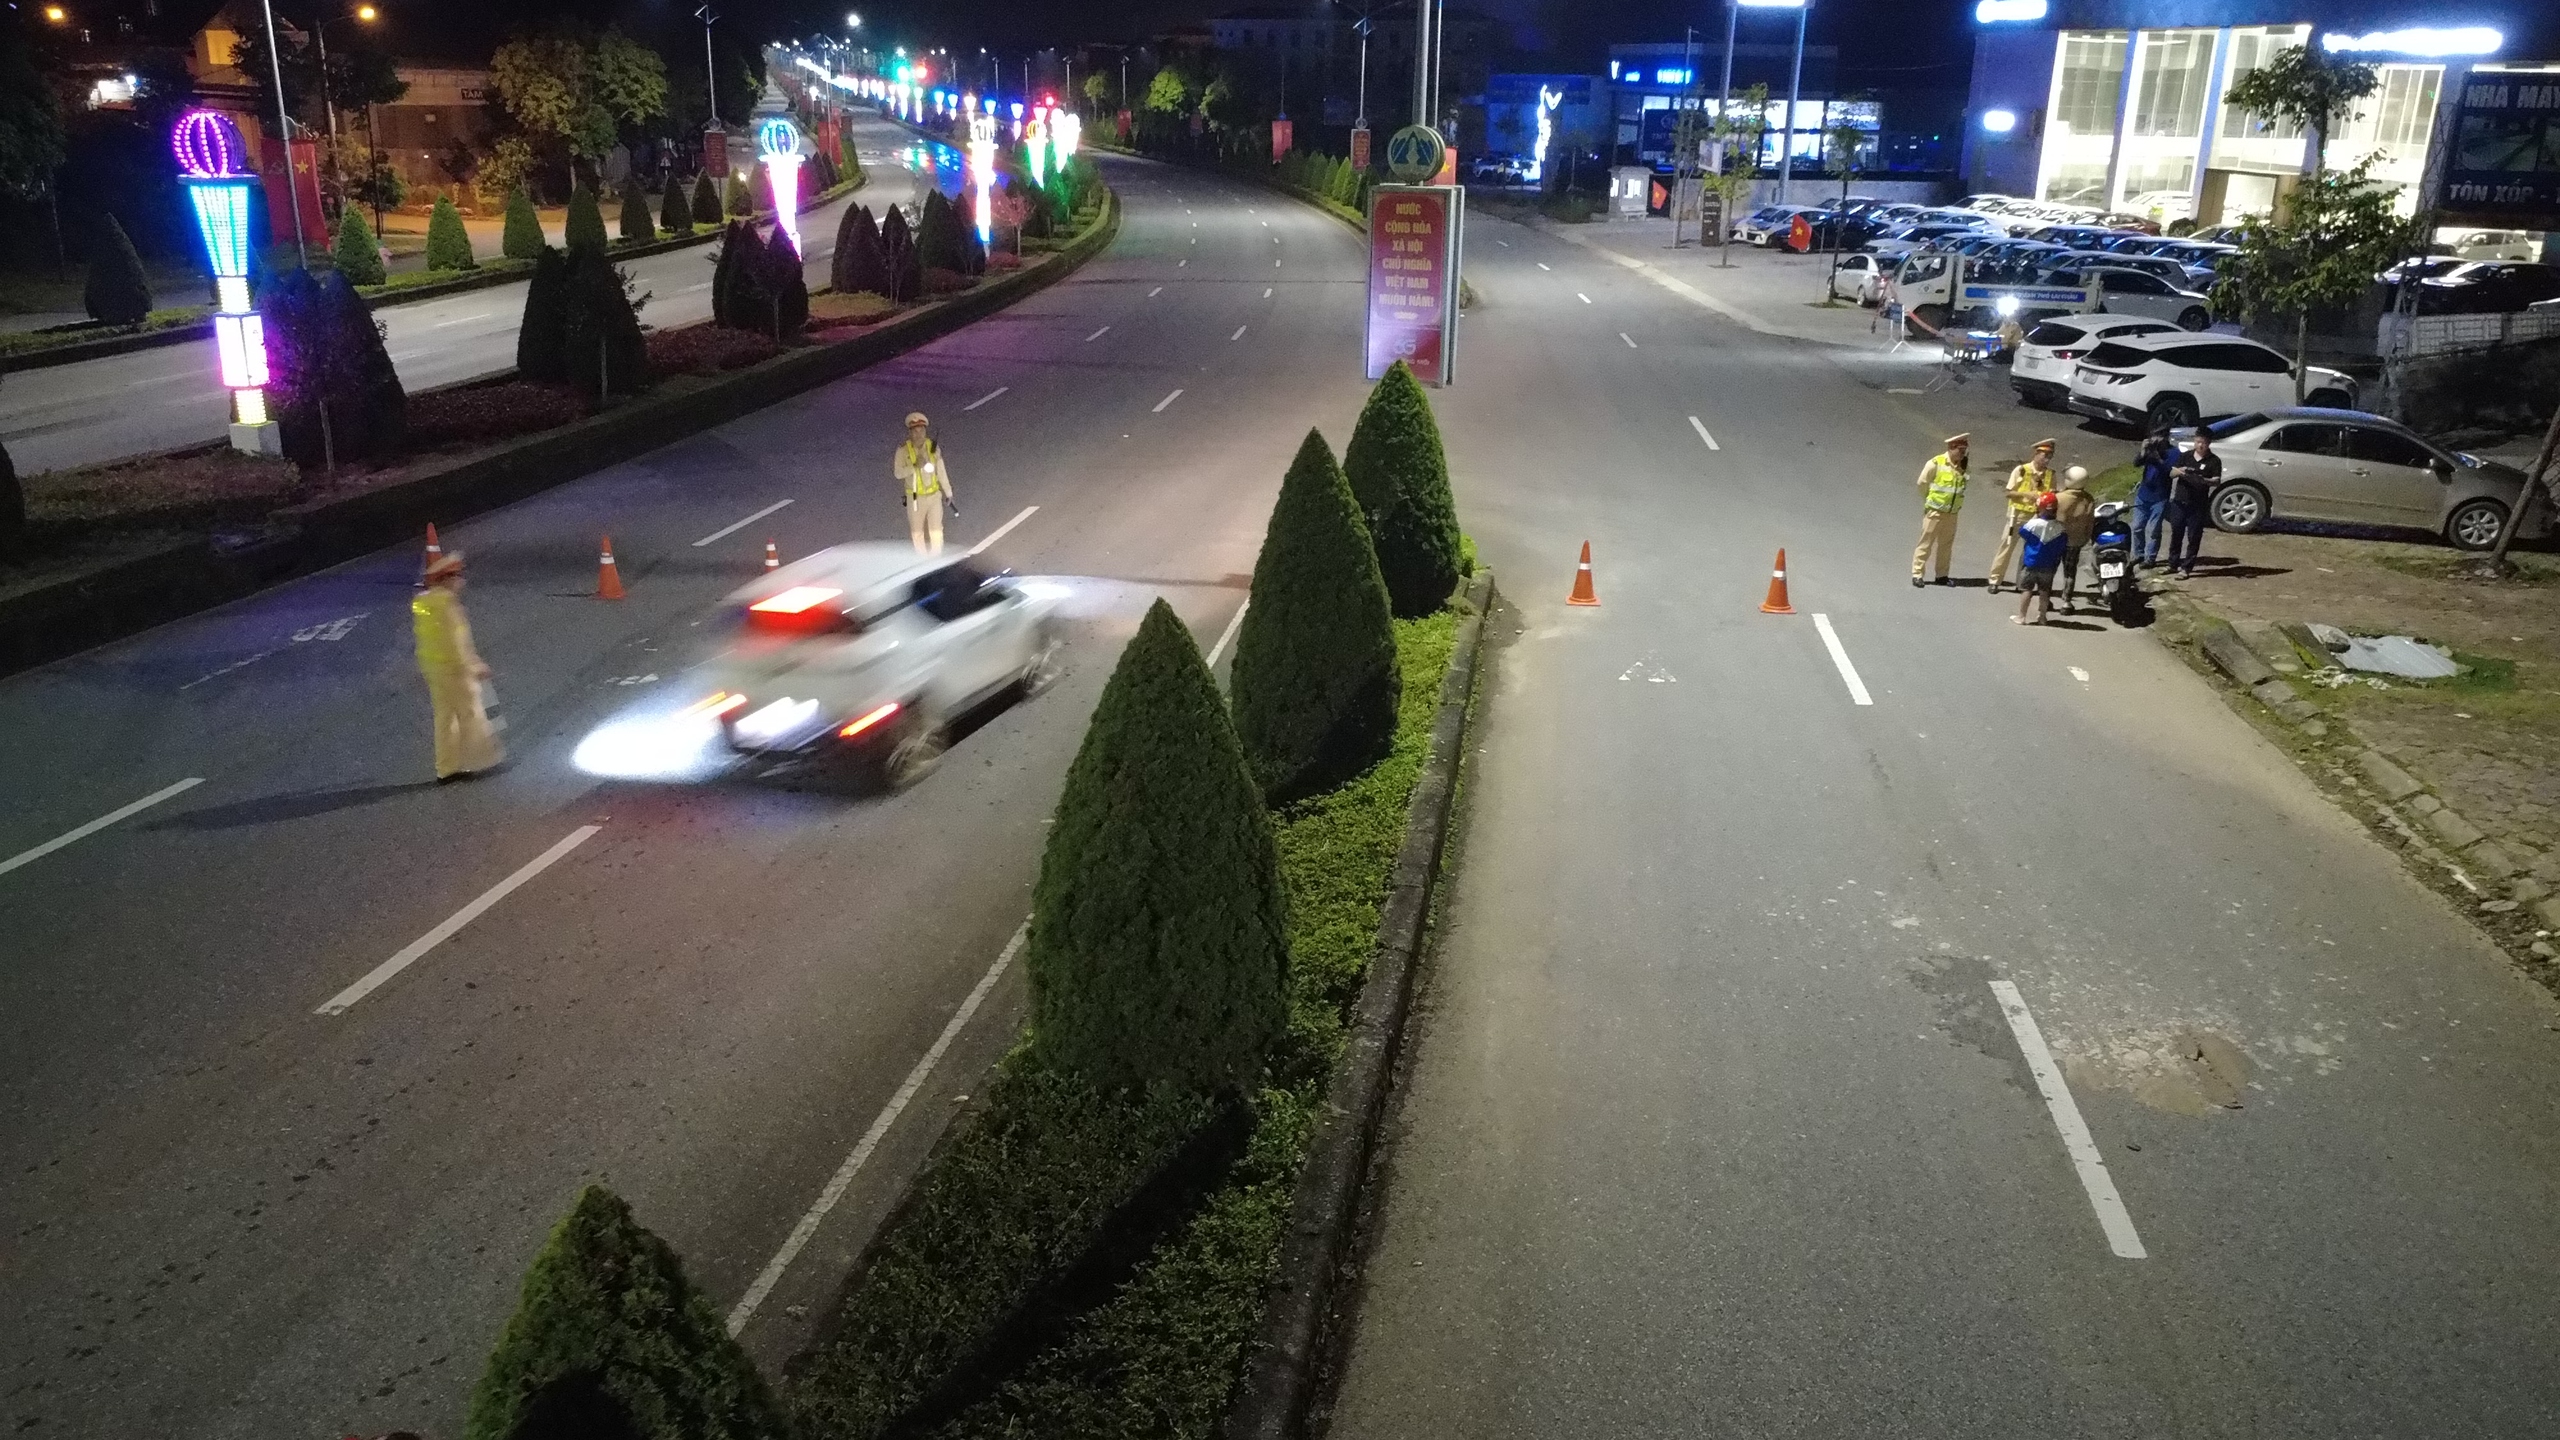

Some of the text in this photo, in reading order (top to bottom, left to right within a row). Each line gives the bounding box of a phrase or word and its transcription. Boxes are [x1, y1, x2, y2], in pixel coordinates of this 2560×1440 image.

[2449, 180, 2489, 202] TÔN
[1396, 202, 1422, 216] NƯỚC
[1385, 219, 1411, 235] CỘNG
[1407, 238, 1423, 254] HỘI
[1382, 256, 1432, 271] CHỦ NGHĨA
[1385, 274, 1429, 290] VIỆT NAM
[1379, 292, 1407, 306] MUÔN
